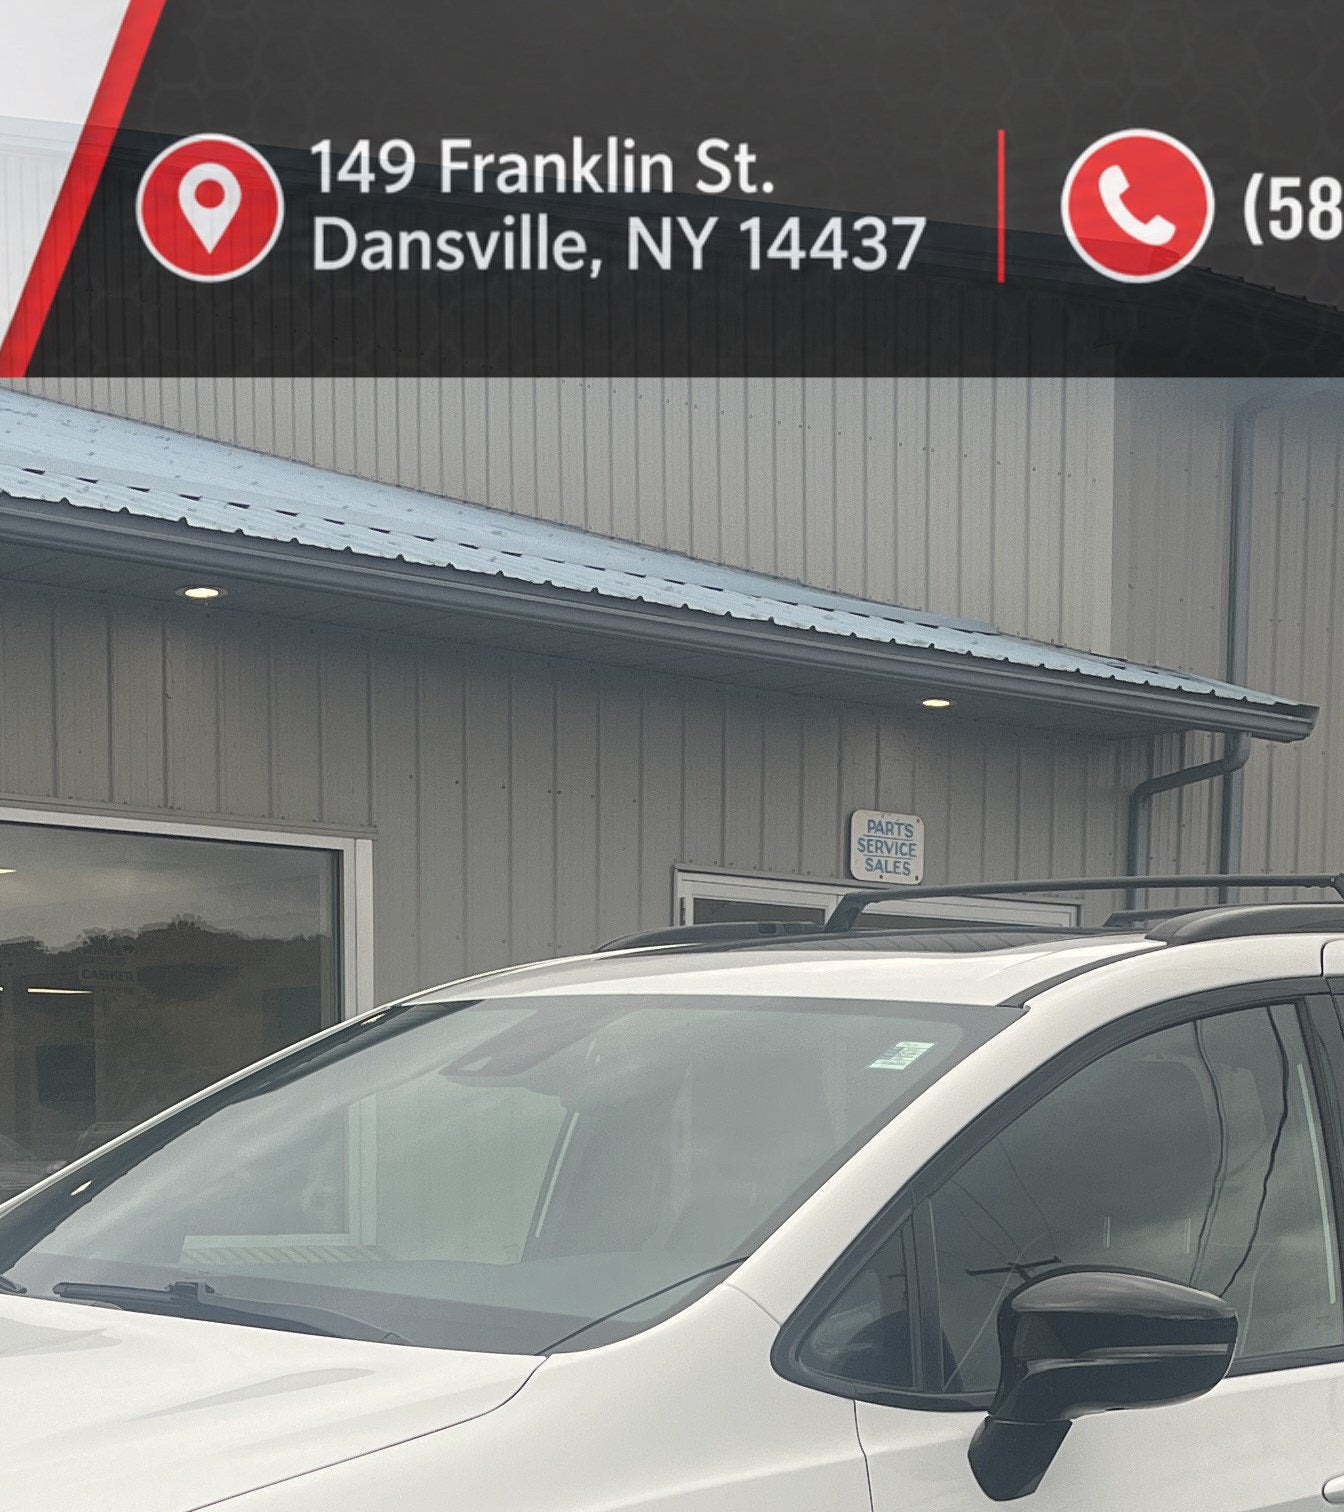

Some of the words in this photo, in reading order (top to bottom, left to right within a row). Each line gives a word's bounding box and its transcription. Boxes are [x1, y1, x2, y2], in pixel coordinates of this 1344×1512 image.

[867, 819, 914, 838] PARTS
[857, 837, 918, 857] SERVICE
[865, 858, 911, 876] SALES
